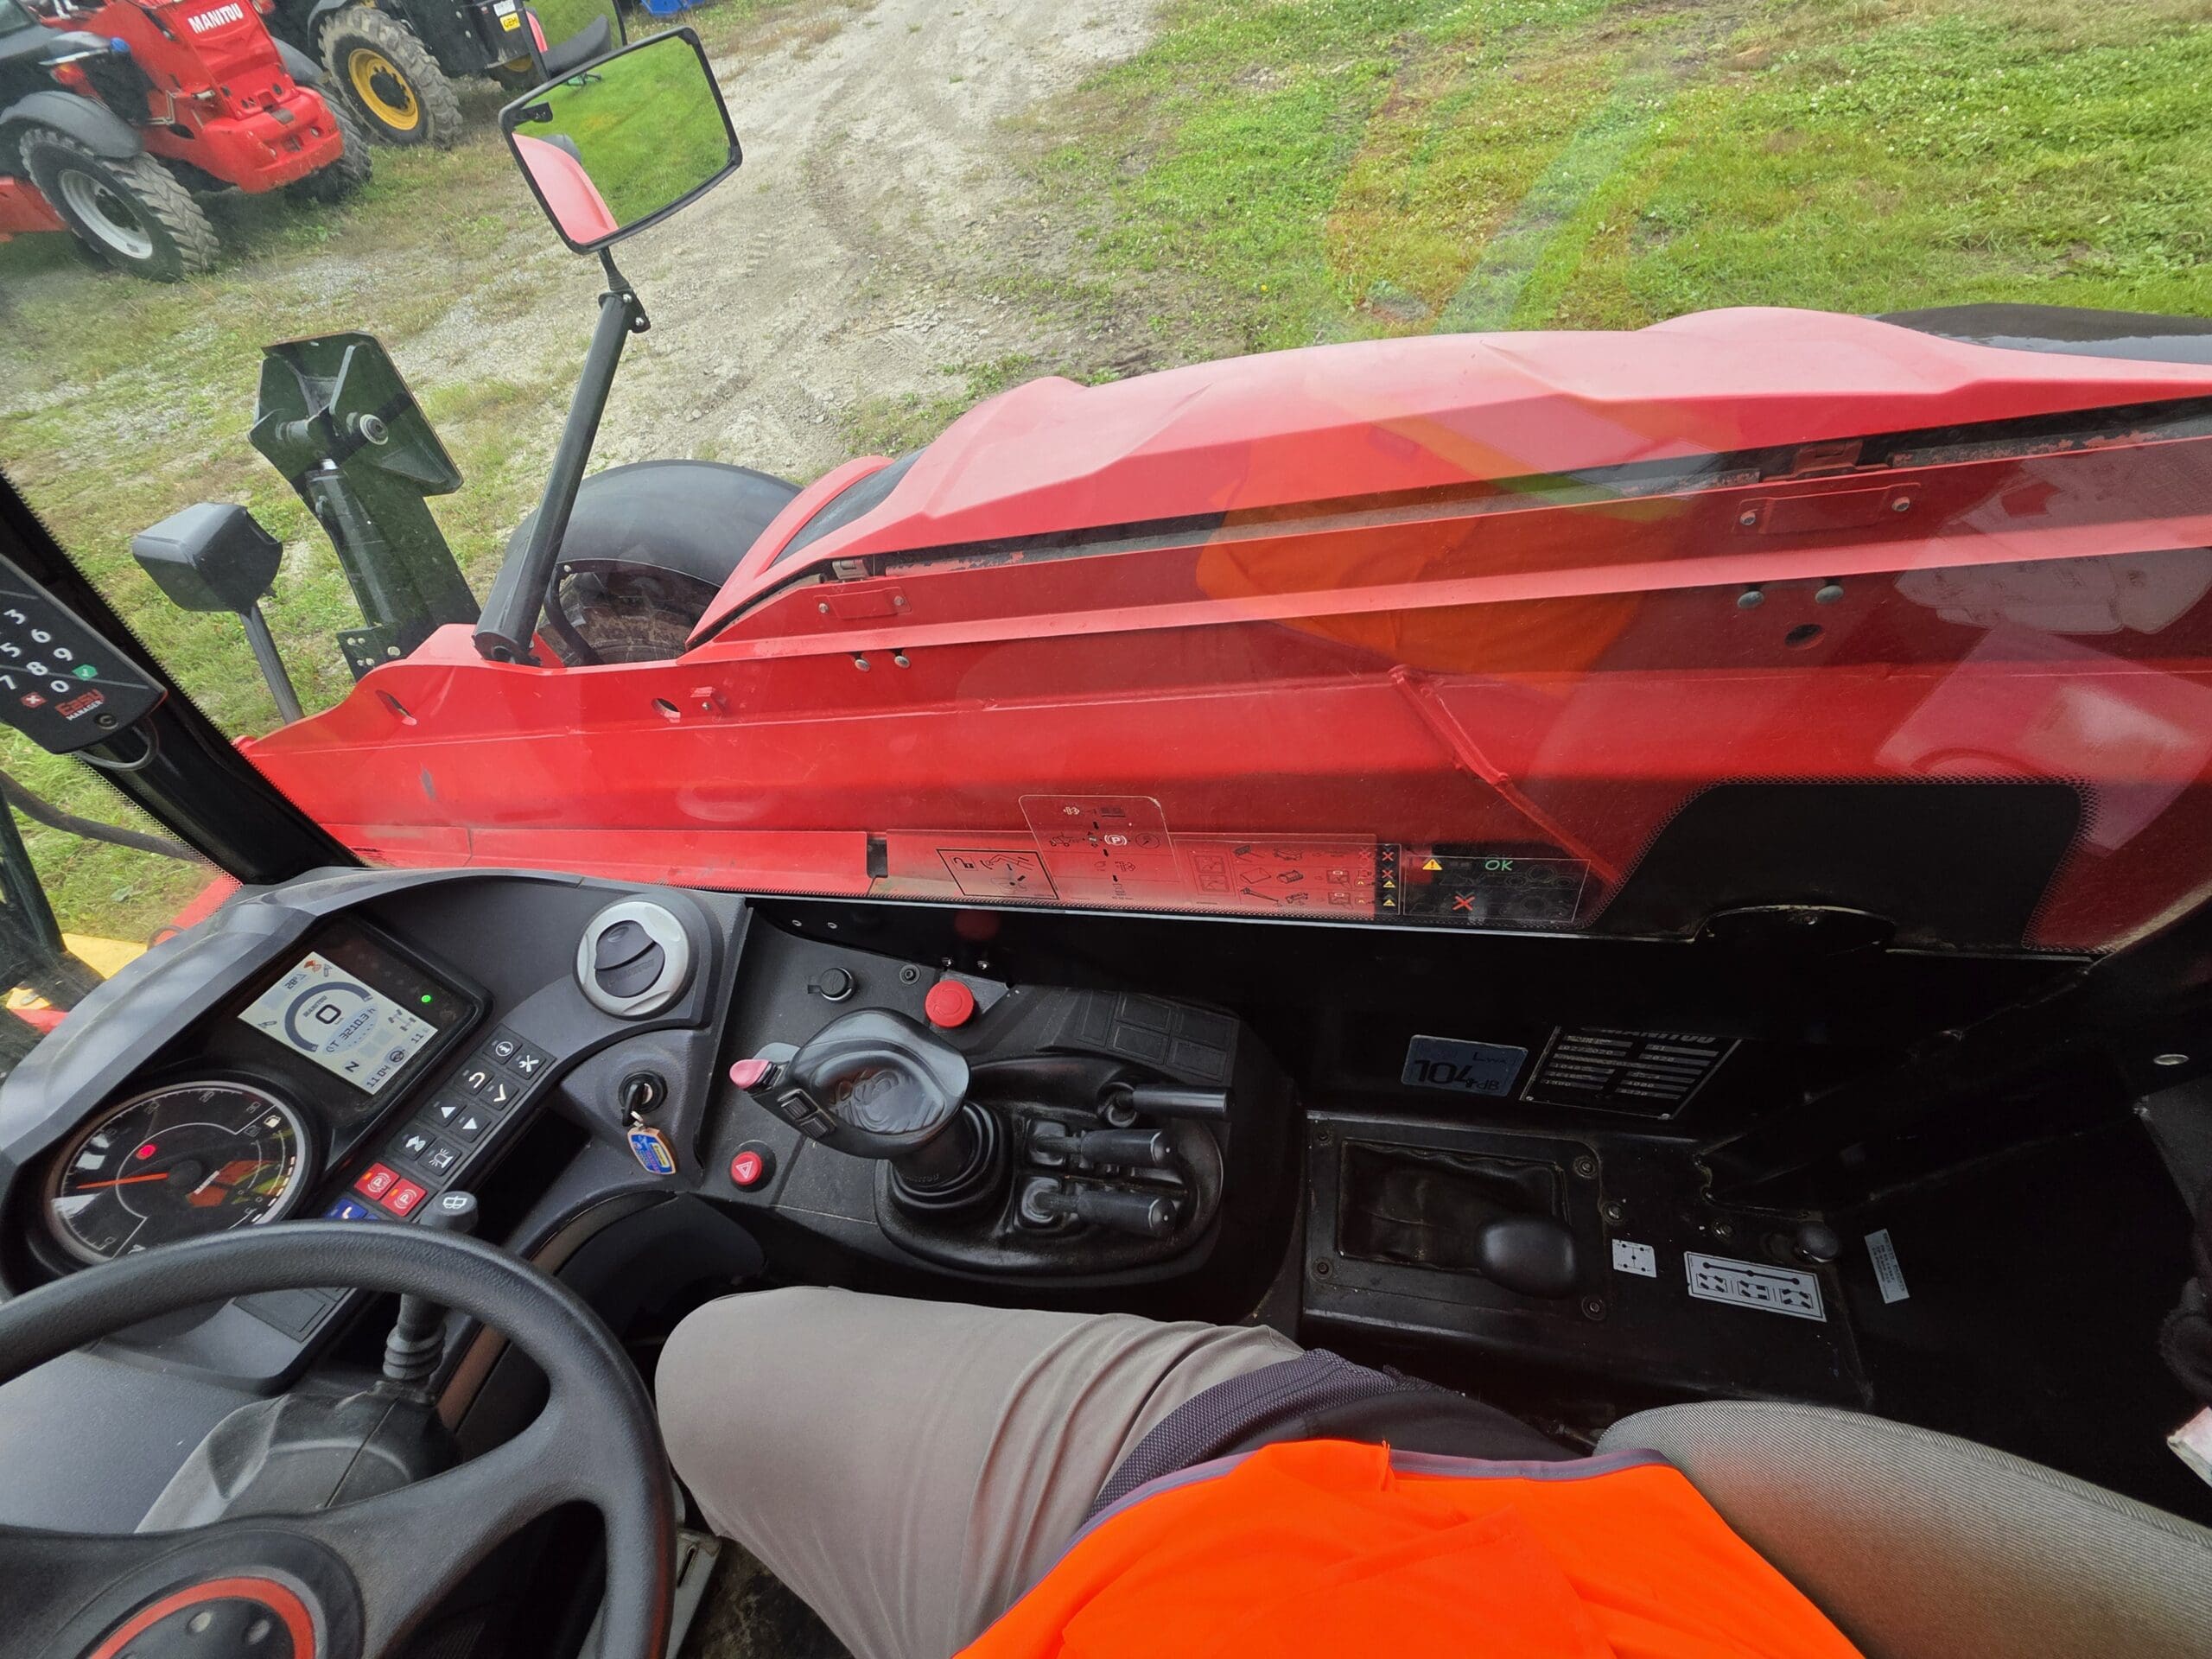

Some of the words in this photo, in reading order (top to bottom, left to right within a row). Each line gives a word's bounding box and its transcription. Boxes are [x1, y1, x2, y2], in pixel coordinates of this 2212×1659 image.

[188, 3, 244, 34] MANITOU
[3, 608, 26, 625] 3
[31, 629, 52, 643] 6
[0, 642, 22, 658] 5
[53, 647, 73, 661] 9
[26, 661, 48, 676] 8
[0, 674, 17, 690] 7
[50, 680, 70, 693] 0
[66, 699, 104, 721] MANAGER
[1484, 859, 1514, 872] OK
[315, 1004, 342, 1025] 0
[345, 1061, 359, 1072] N
[1414, 1059, 1473, 1084] 104
[1477, 1078, 1500, 1091] dB
[245, 1101, 262, 1114] 30
